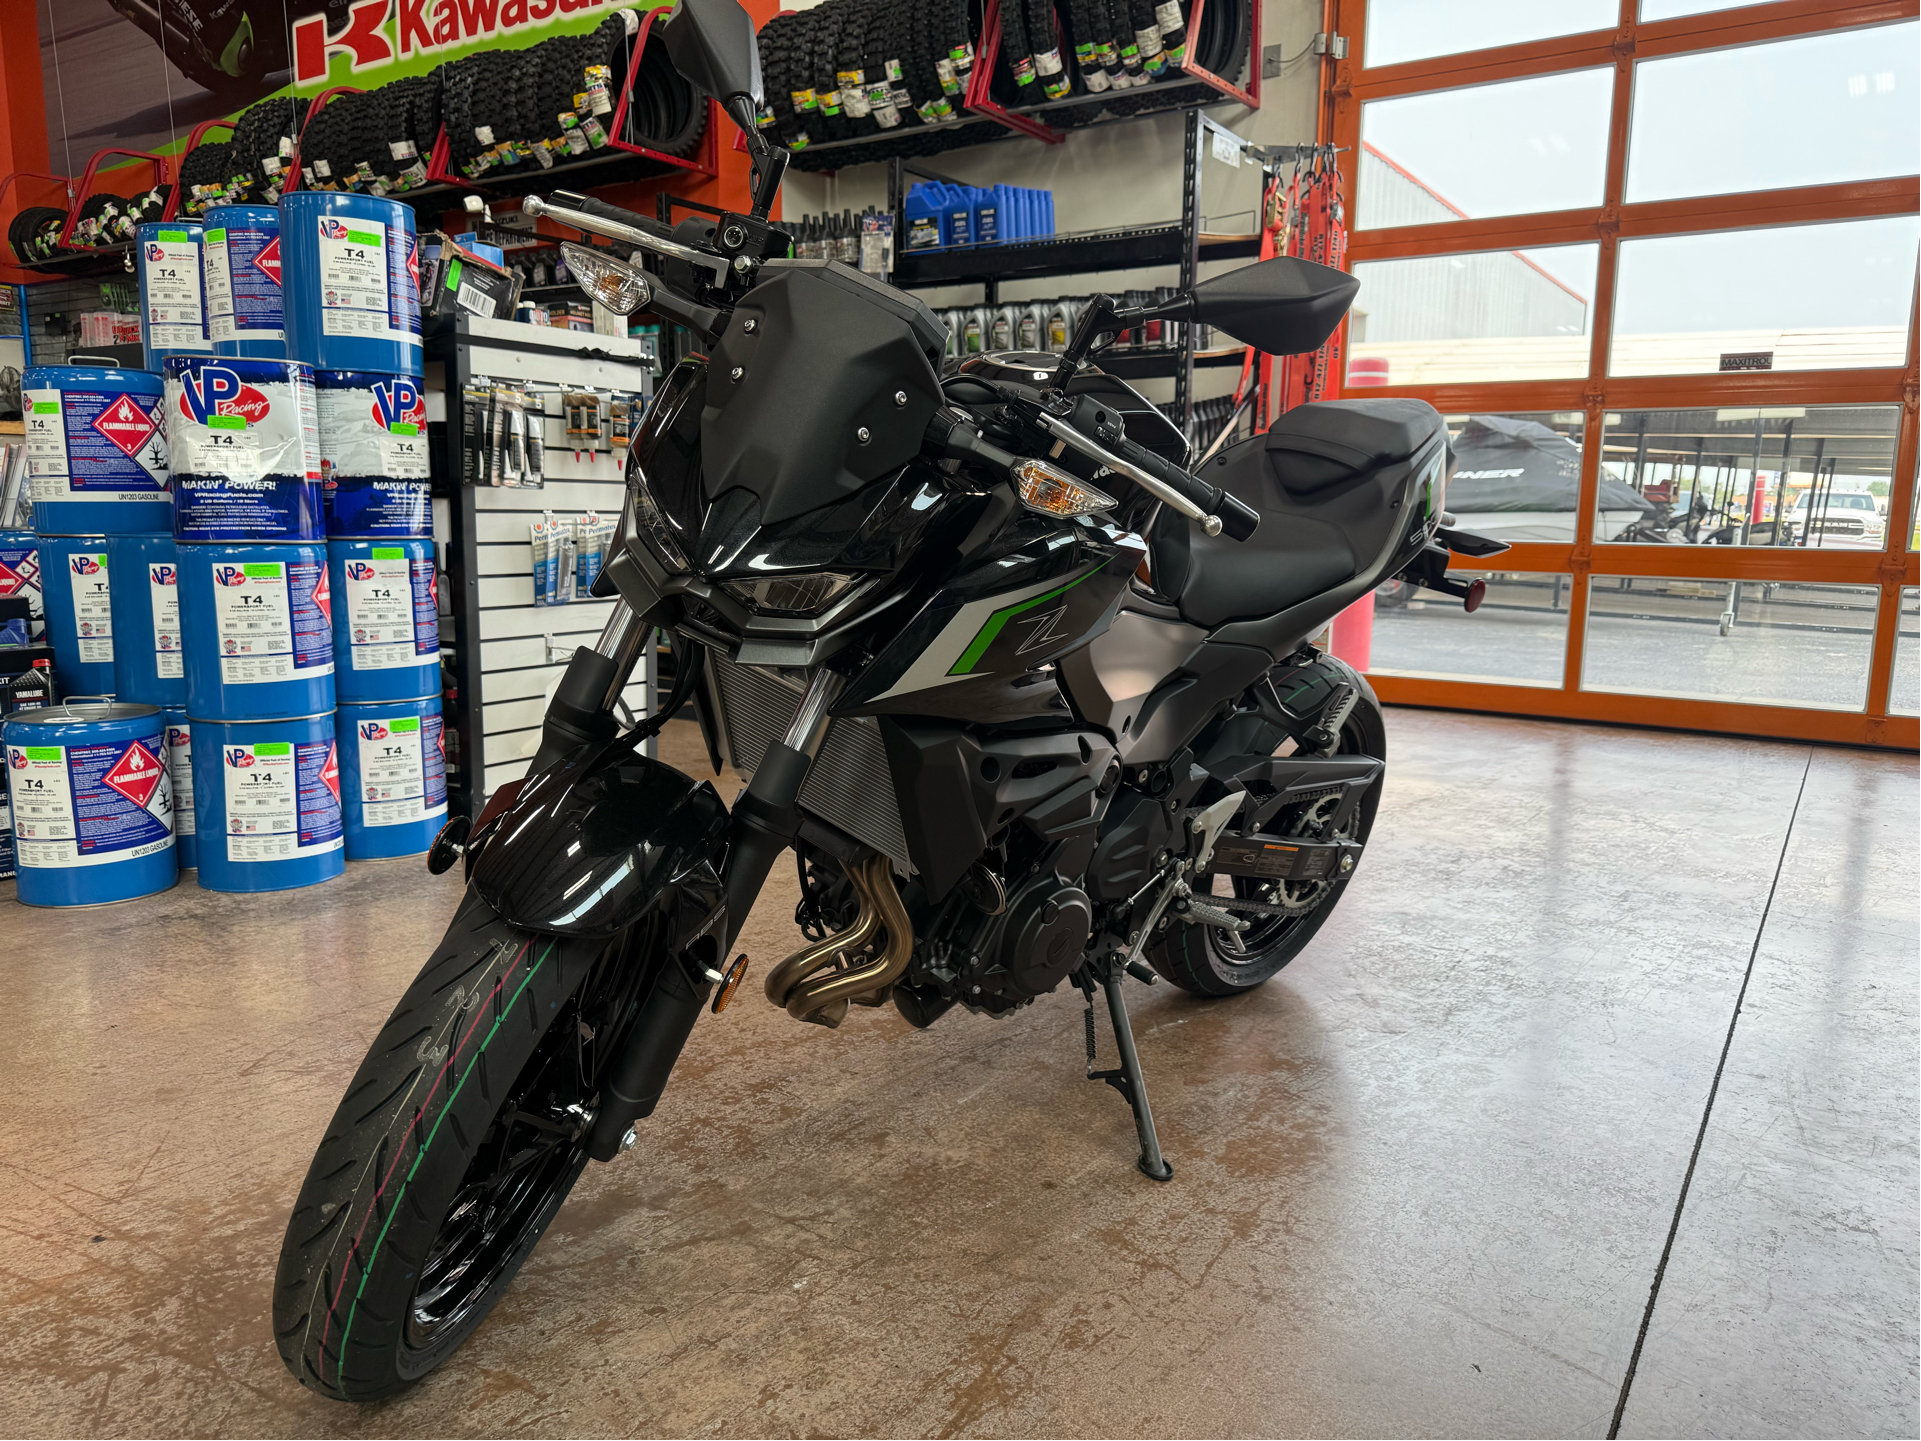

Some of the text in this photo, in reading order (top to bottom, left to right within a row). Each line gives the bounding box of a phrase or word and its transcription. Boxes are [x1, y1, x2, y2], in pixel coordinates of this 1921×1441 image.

[344, 248, 366, 259] T4
[159, 269, 177, 278] T4
[1720, 357, 1772, 367] MAXITROL
[180, 366, 242, 425] VP
[220, 400, 269, 416] Racing
[371, 381, 417, 431] VP
[32, 420, 45, 429] T4
[103, 422, 151, 432] FLAMMABLE LIQUID
[210, 435, 234, 445] T4
[127, 443, 132, 451] 3
[397, 443, 414, 452] T4
[182, 480, 277, 491] MAKIN' POWER!
[373, 481, 408, 490] MAKIN'
[138, 493, 160, 501] GASOLINE
[588, 522, 616, 535] Permatex
[372, 589, 391, 598] T4
[240, 595, 264, 605] T4
[1014, 604, 1069, 656] Z
[15, 689, 43, 699] YAMALUBE
[383, 746, 402, 756] T4
[113, 768, 159, 784] FLAMMABLE LIQUID
[250, 772, 272, 782] T4
[25, 780, 44, 789] T4
[138, 793, 143, 801] 3
[131, 839, 169, 857] UN1203 GASOLINE
[685, 904, 726, 950] ABS
